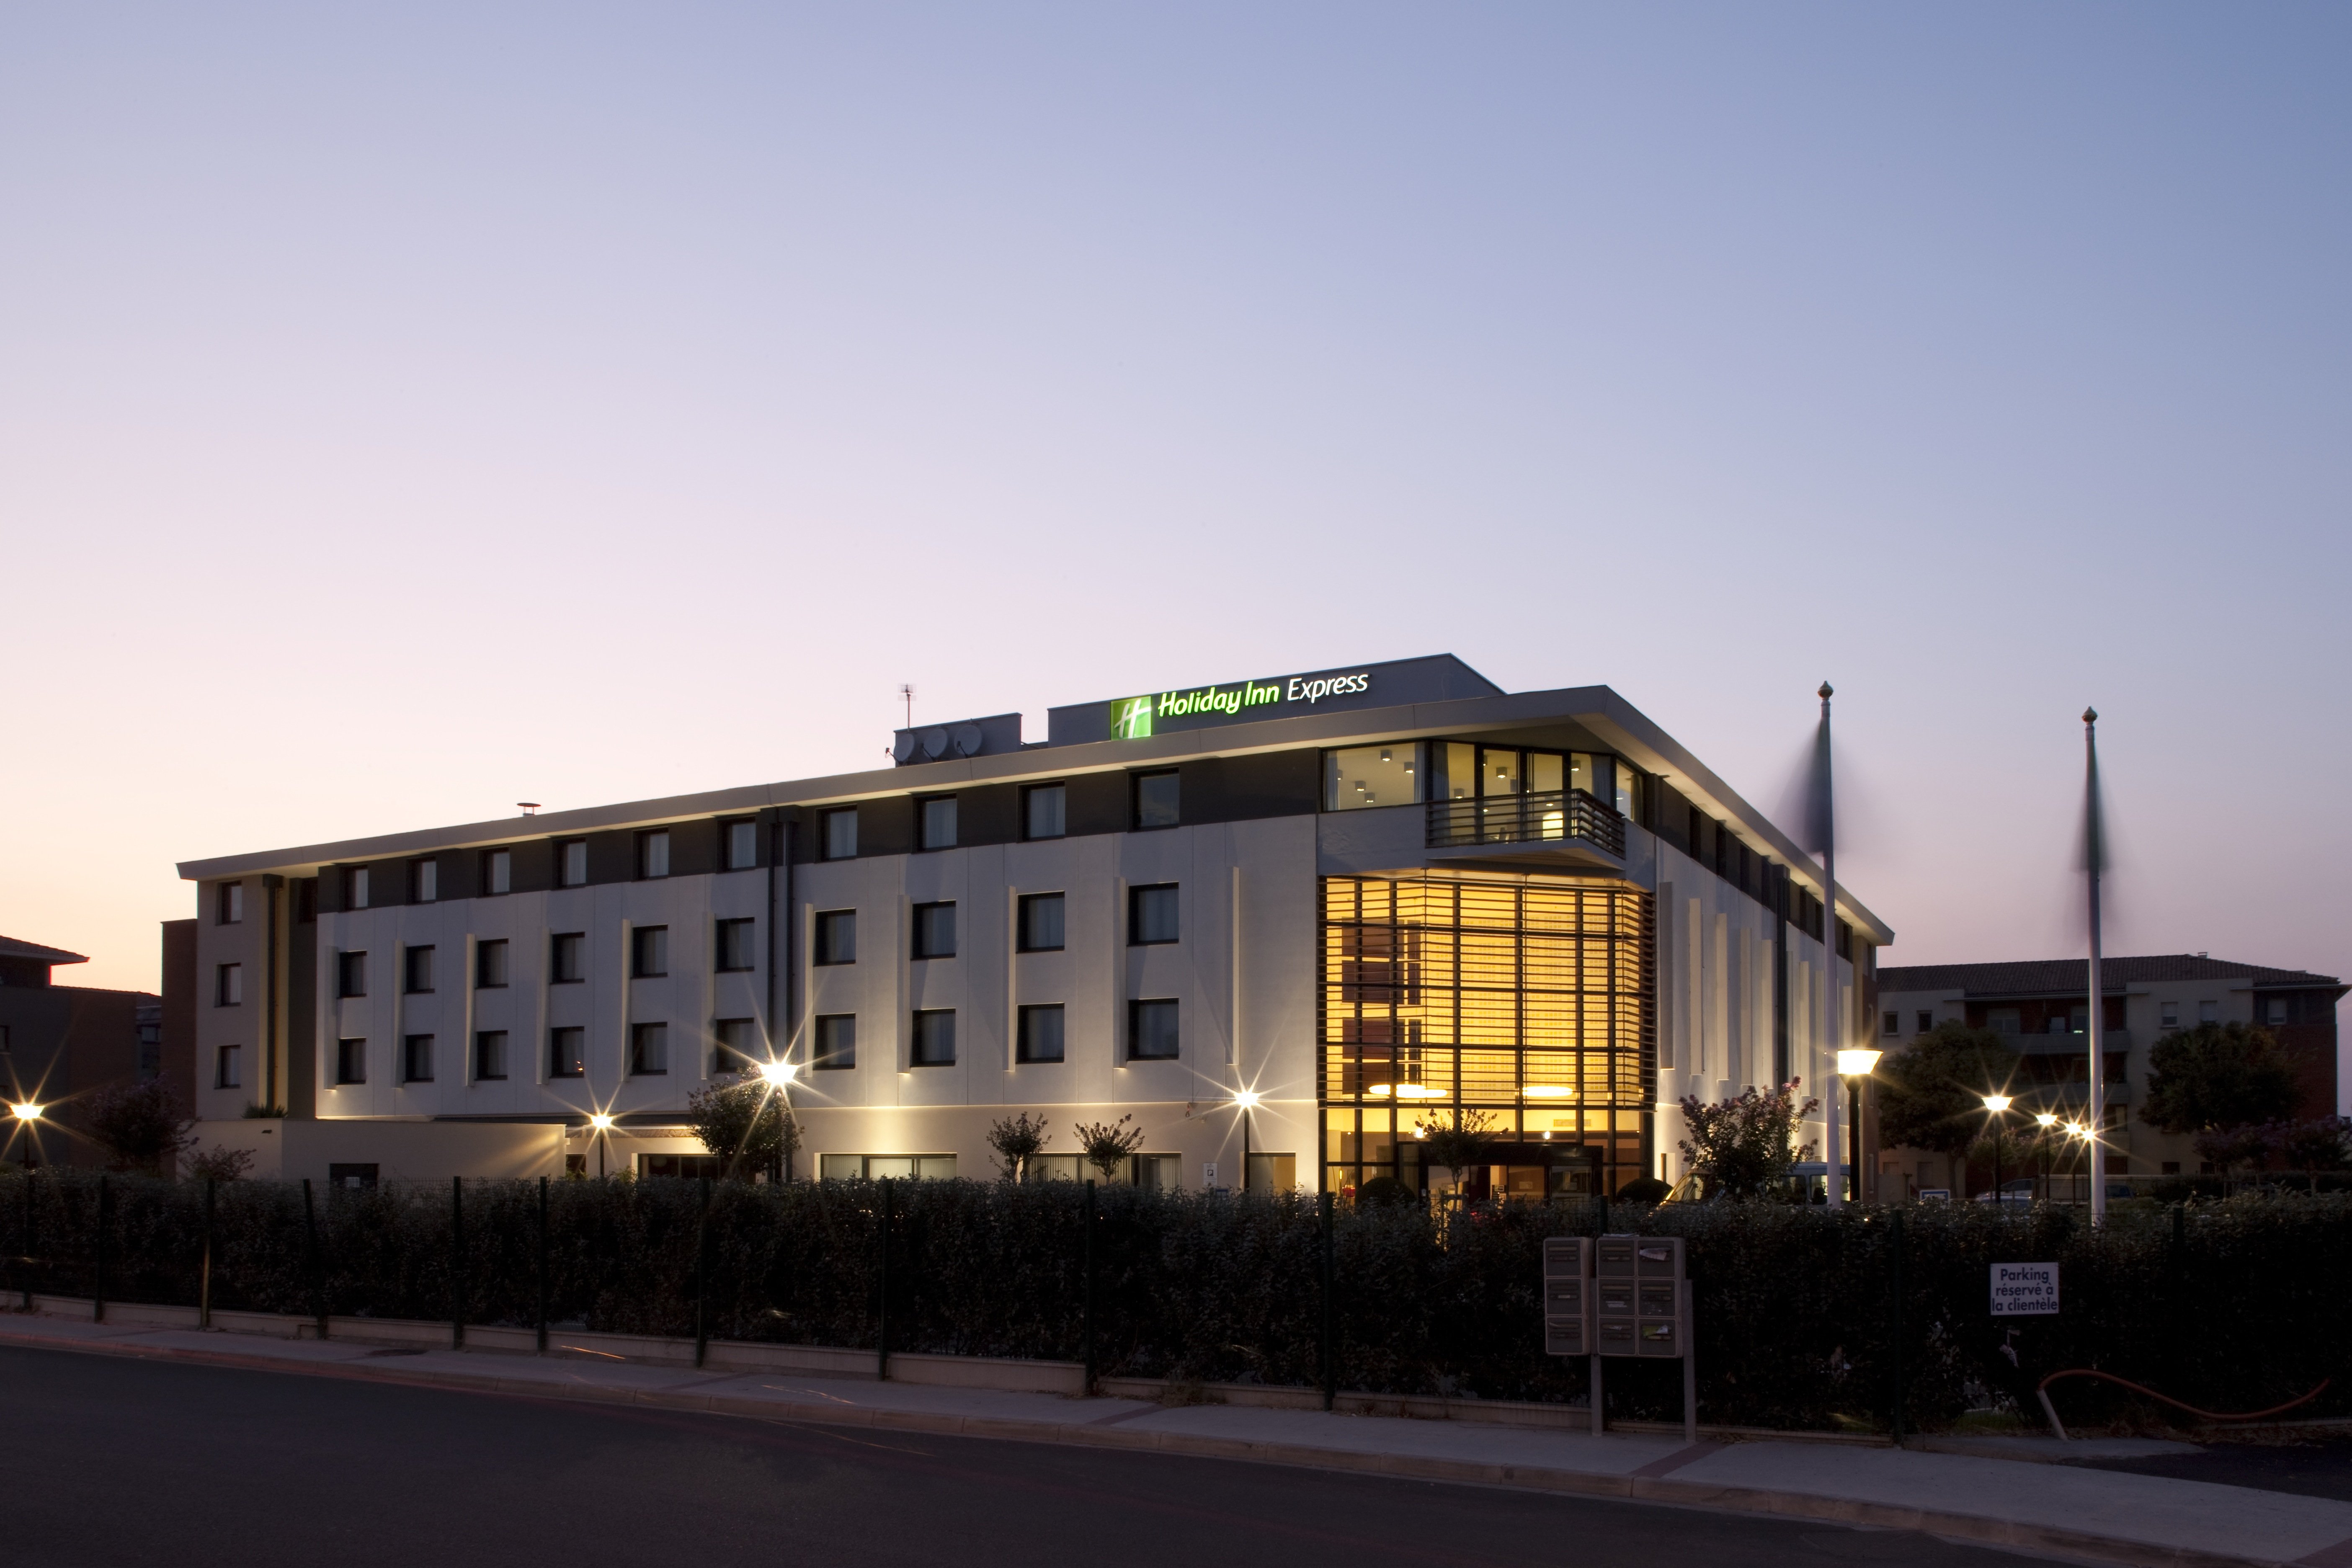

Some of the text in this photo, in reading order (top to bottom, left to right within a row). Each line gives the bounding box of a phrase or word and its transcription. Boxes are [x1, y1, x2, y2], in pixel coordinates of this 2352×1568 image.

[1158, 674, 1369, 717] Holiday Inn Express
[2000, 1267, 2049, 1284] Parking
[1996, 1282, 2054, 1297] réservé à
[1992, 1297, 2058, 1312] la clientèle
